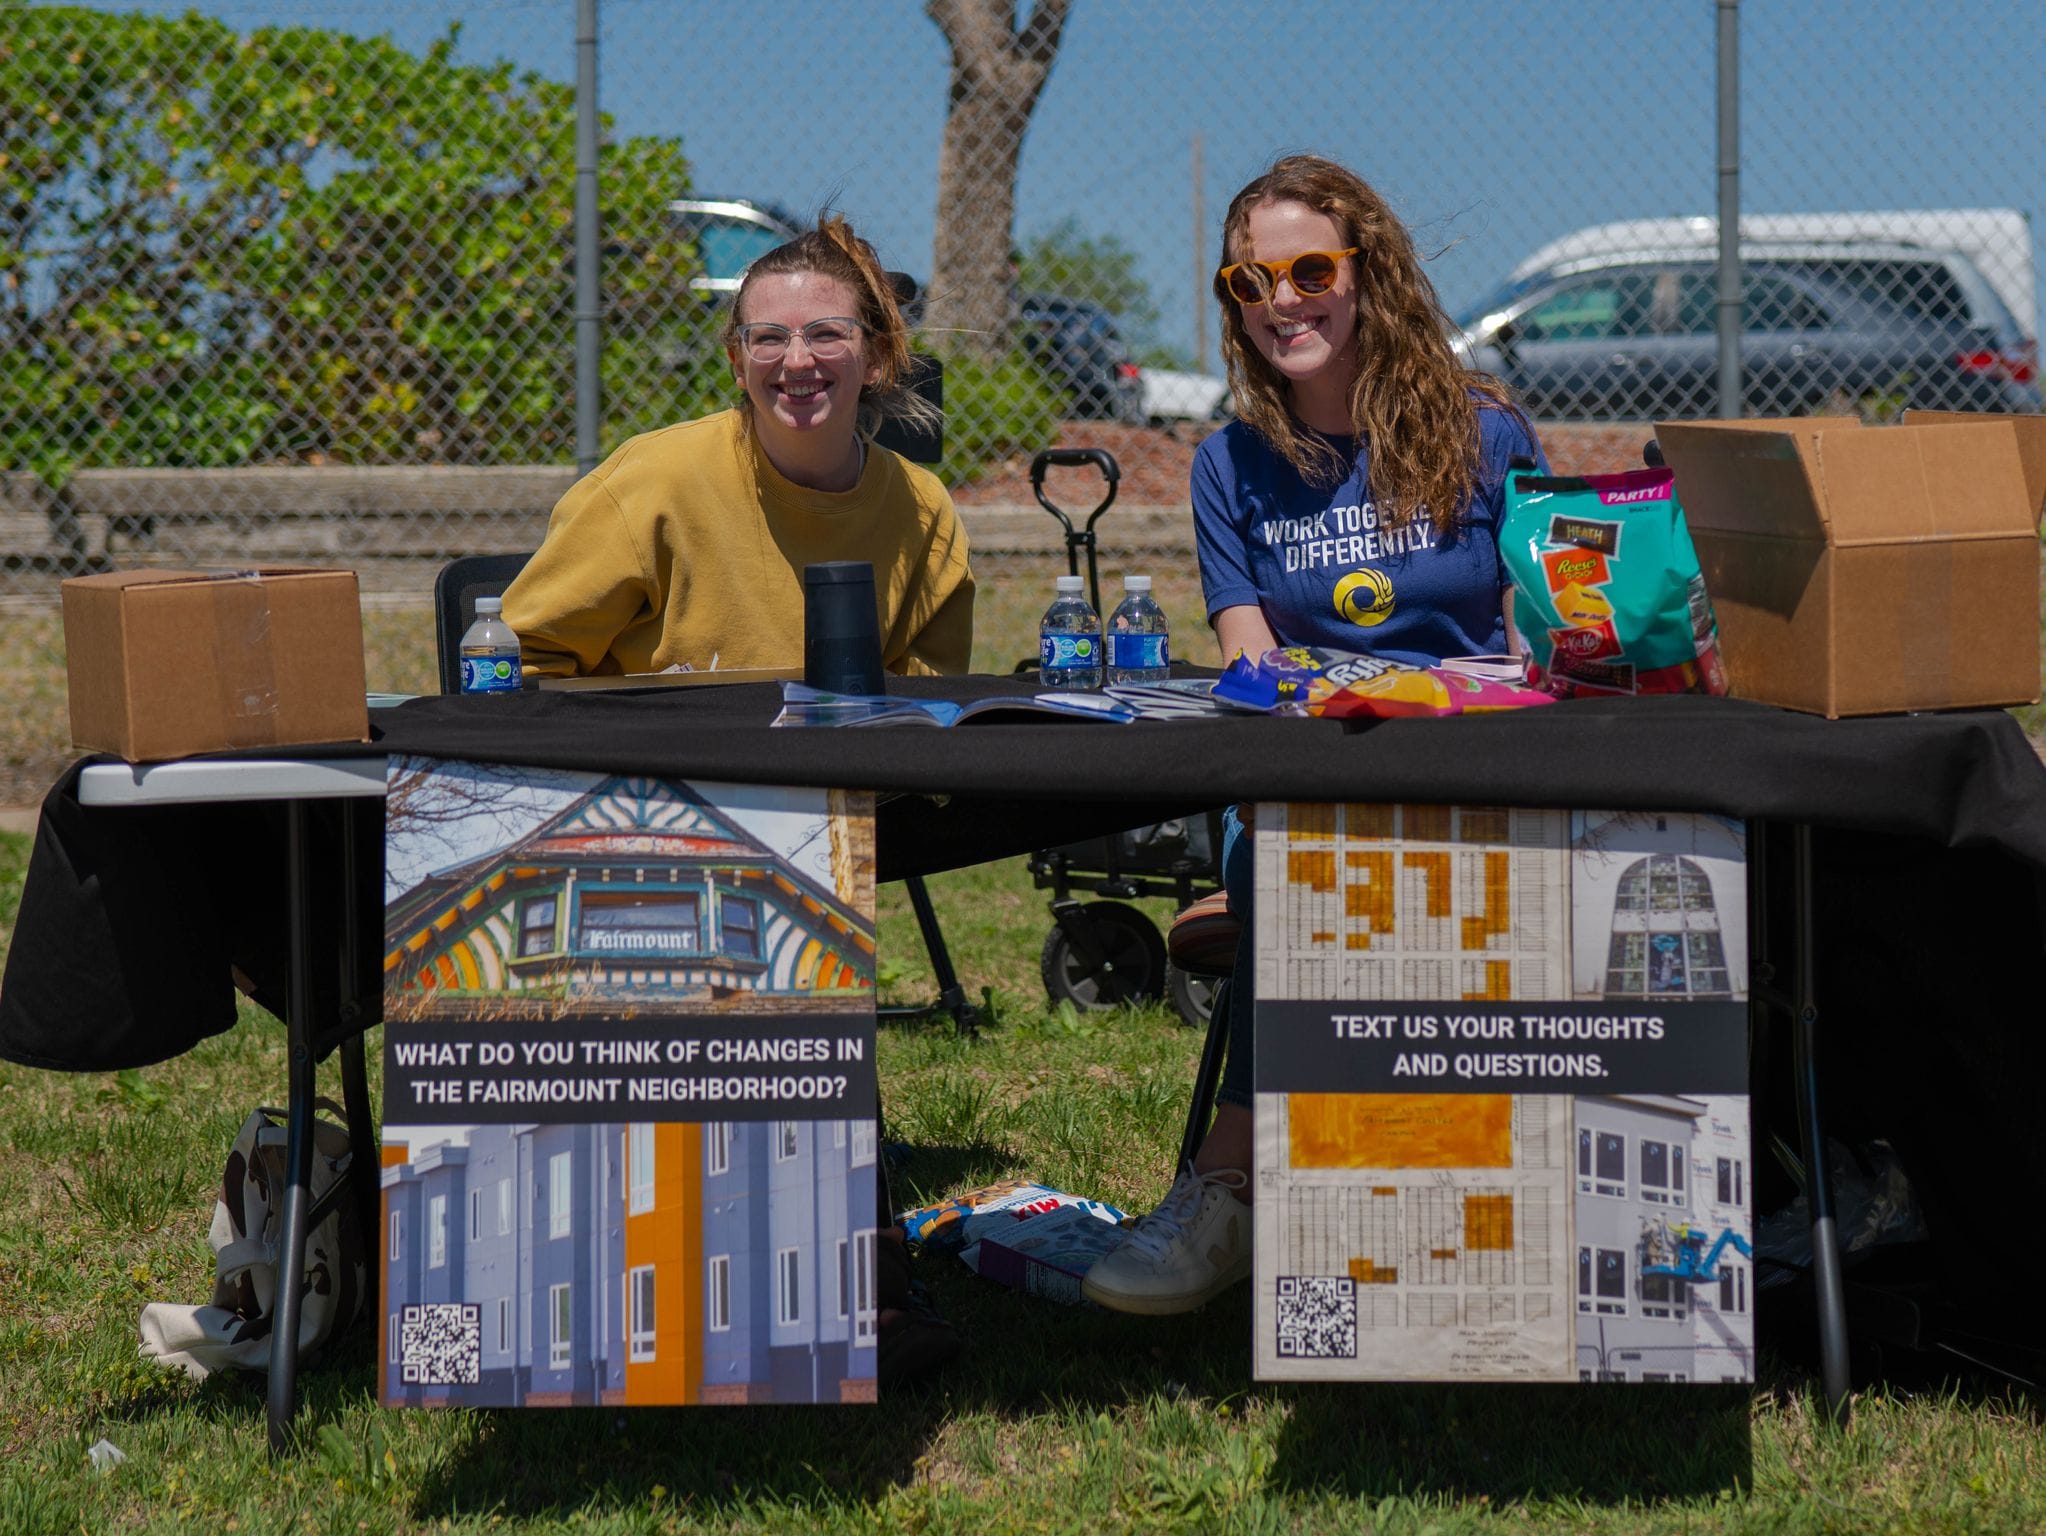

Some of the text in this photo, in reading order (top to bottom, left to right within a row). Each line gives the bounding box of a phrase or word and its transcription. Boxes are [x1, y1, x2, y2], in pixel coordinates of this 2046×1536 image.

[1607, 487, 1657, 503] PARTY
[1263, 511, 1329, 545] WORK
[1567, 525, 1603, 544] HEATH
[1286, 522, 1436, 573] DIFFERENTLY.
[589, 930, 693, 950] Fairmount
[1331, 1016, 1665, 1039] TEXT US YOUR THOUGHTS
[395, 1038, 863, 1066] WHAT DO YOU THINK OF CHANGES IN
[1393, 1054, 1609, 1079] AND QUESTIONS.
[411, 1076, 847, 1103] THE FAIRMOUNT NEIGHBORHOOD?
